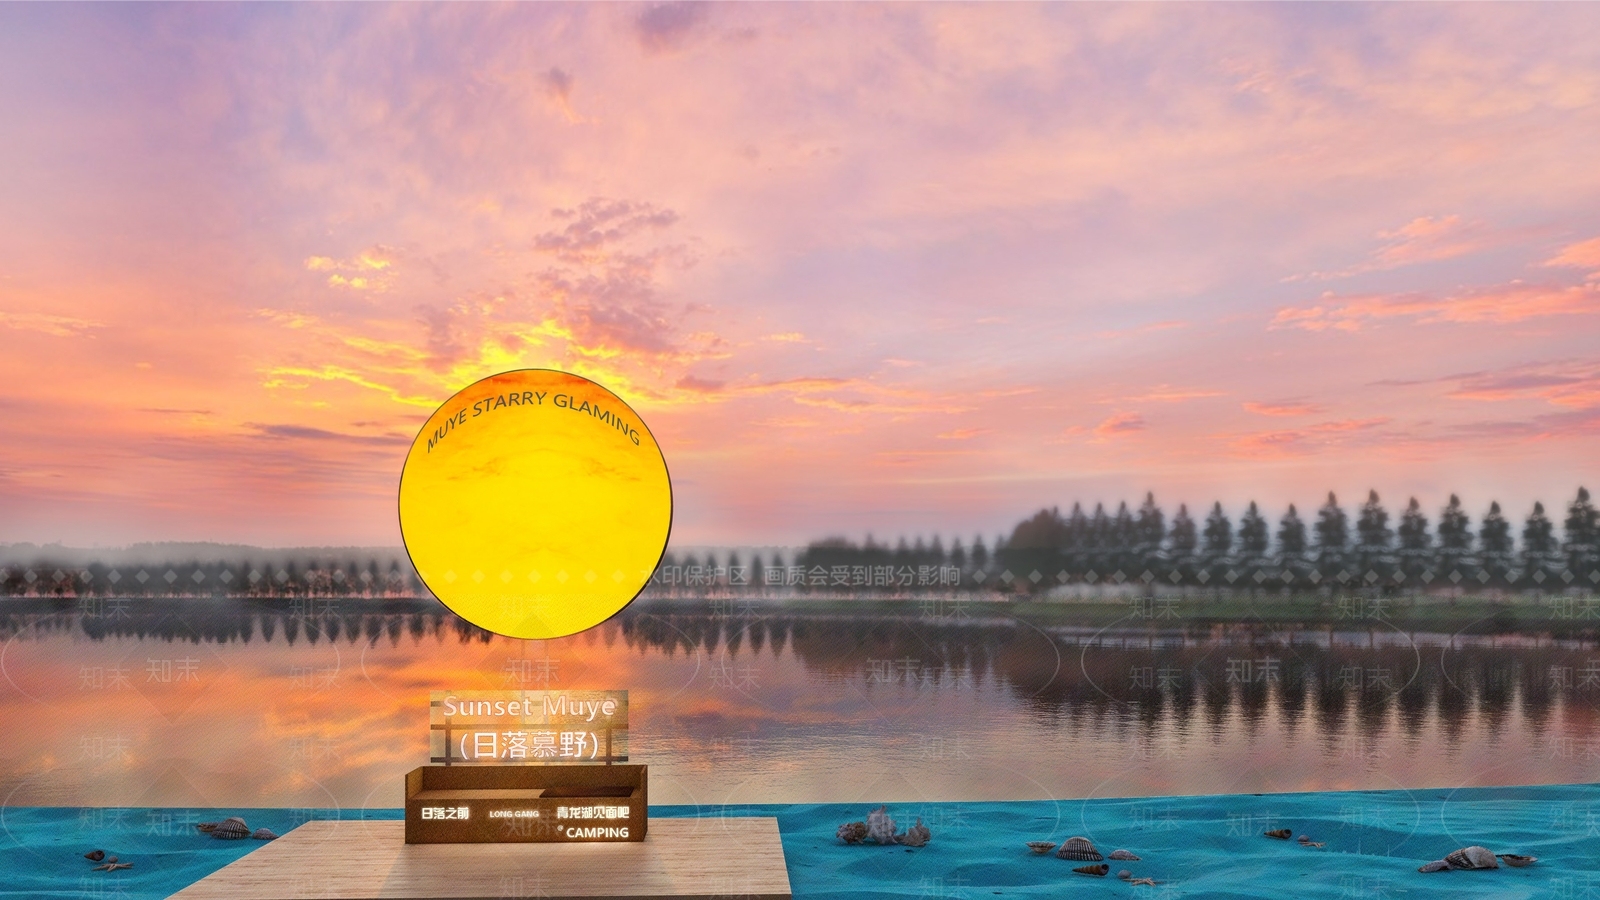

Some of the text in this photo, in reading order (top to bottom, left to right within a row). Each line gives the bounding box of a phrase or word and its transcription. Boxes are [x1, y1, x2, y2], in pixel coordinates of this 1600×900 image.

[428, 391, 639, 453] MUYE STARRY GLAMING
[443, 696, 616, 722] Sunset Muye
[421, 807, 469, 820] 日落之前
[557, 806, 630, 819] 青龙湖见面吧
[566, 827, 629, 838] CAMPING
